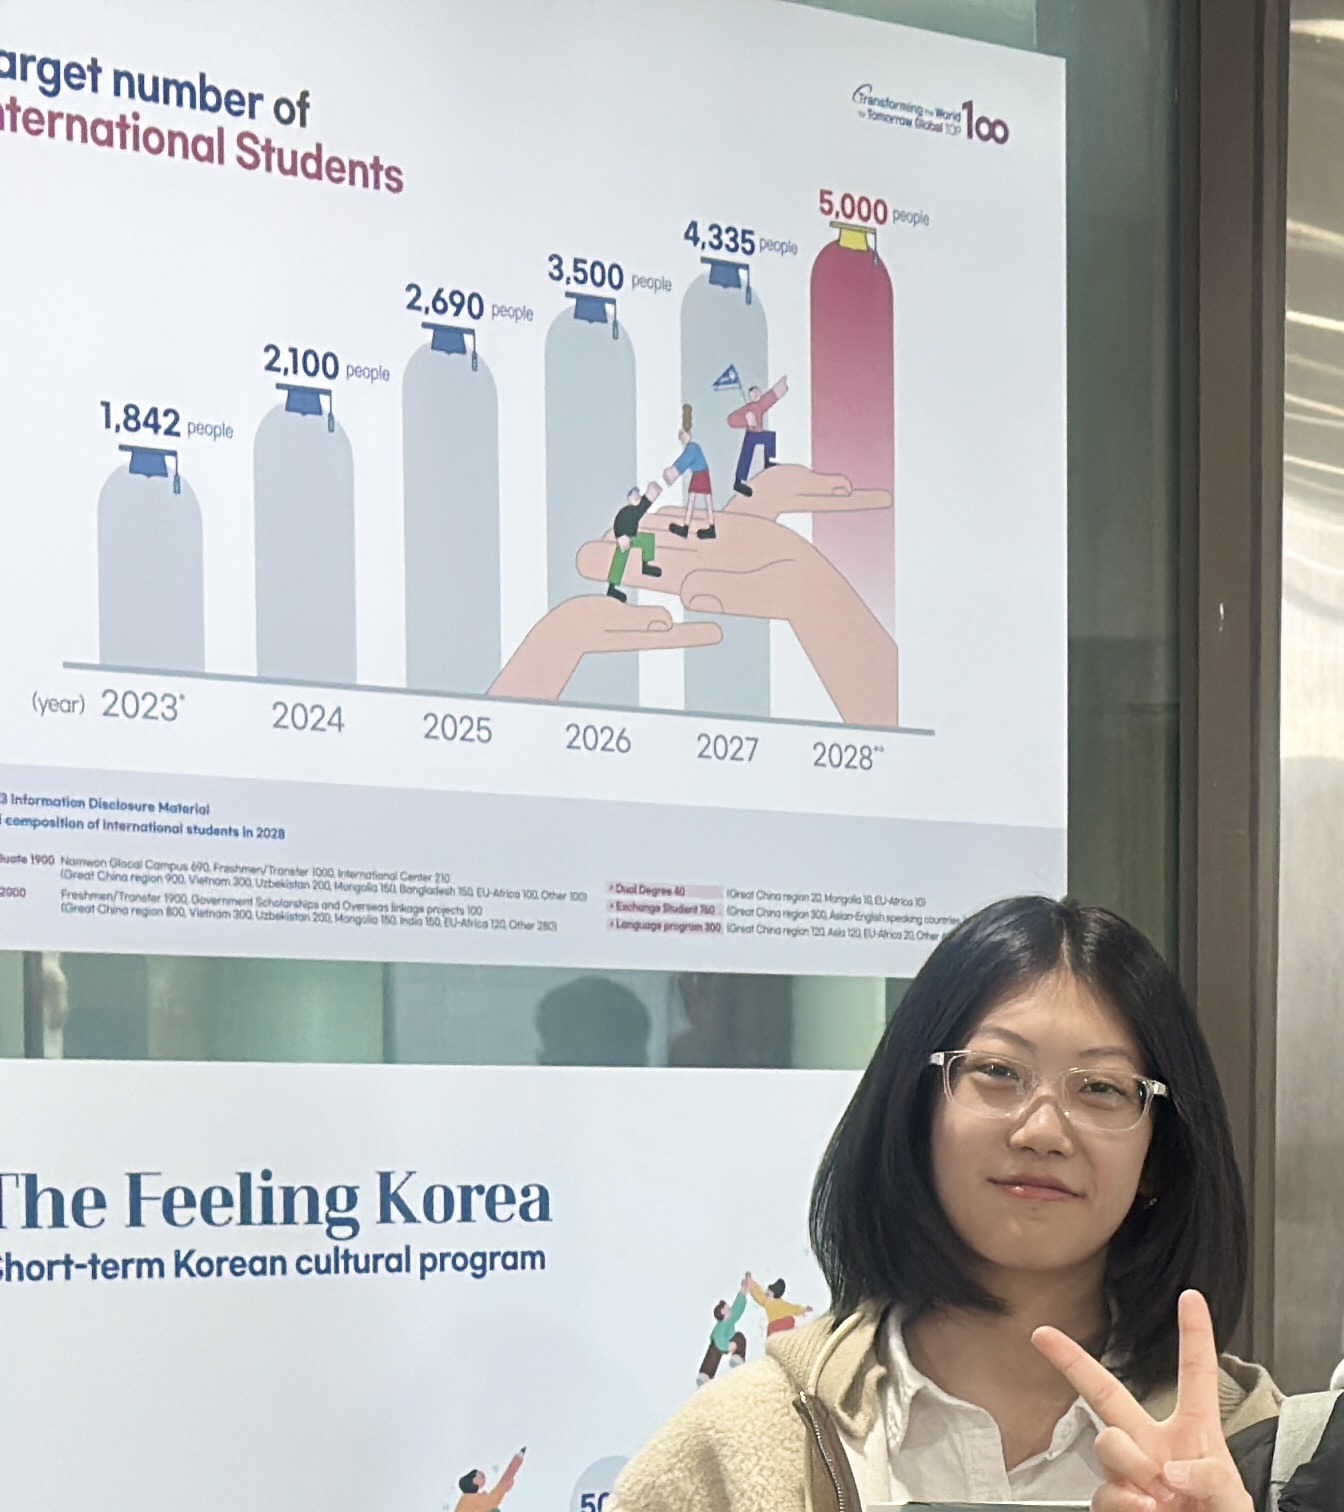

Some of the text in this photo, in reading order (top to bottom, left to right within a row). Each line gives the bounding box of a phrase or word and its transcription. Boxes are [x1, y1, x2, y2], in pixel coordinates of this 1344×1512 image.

[113, 68, 263, 120] number
[273, 90, 311, 128] of
[857, 90, 924, 116] Transforming
[935, 107, 961, 122] World
[915, 116, 943, 133] Global
[0, 95, 405, 194] ternational Students
[819, 188, 930, 227] 5,000 people
[684, 220, 798, 256] 4,335 people
[548, 254, 672, 293] 3,500 people
[404, 283, 534, 322] 2,690 people
[263, 344, 390, 383] 2,100 people
[100, 401, 234, 440] 1,842 people
[31, 693, 86, 716] (year)
[271, 701, 346, 733] 2024
[423, 713, 493, 744] 2025
[565, 723, 632, 755] 2026
[697, 733, 759, 763] 2027
[11, 794, 85, 809] Information
[89, 798, 155, 813] Disclosure
[158, 802, 210, 815] Material
[5, 817, 84, 830] composition
[87, 819, 101, 830] of
[187, 824, 240, 837] students
[242, 827, 254, 838] in
[256, 827, 285, 840] 2028
[30, 854, 55, 865] 1900
[61, 857, 107, 868] Namwon
[145, 860, 189, 873] Campus
[338, 869, 398, 880] International
[400, 871, 432, 883] Center
[60, 869, 95, 882] (Great
[97, 870, 127, 882] China
[130, 872, 163, 885] region
[188, 874, 231, 887] Vietnam
[255, 878, 310, 890] Uzbekistan
[97, 903, 128, 916] China
[130, 906, 163, 919] region
[189, 907, 231, 920] Vietnam
[321, 899, 340, 910] and
[125, 1168, 361, 1240] Feeling
[375, 1170, 554, 1226] Korea
[0, 1245, 547, 1283] hort-term Korean cultural program
